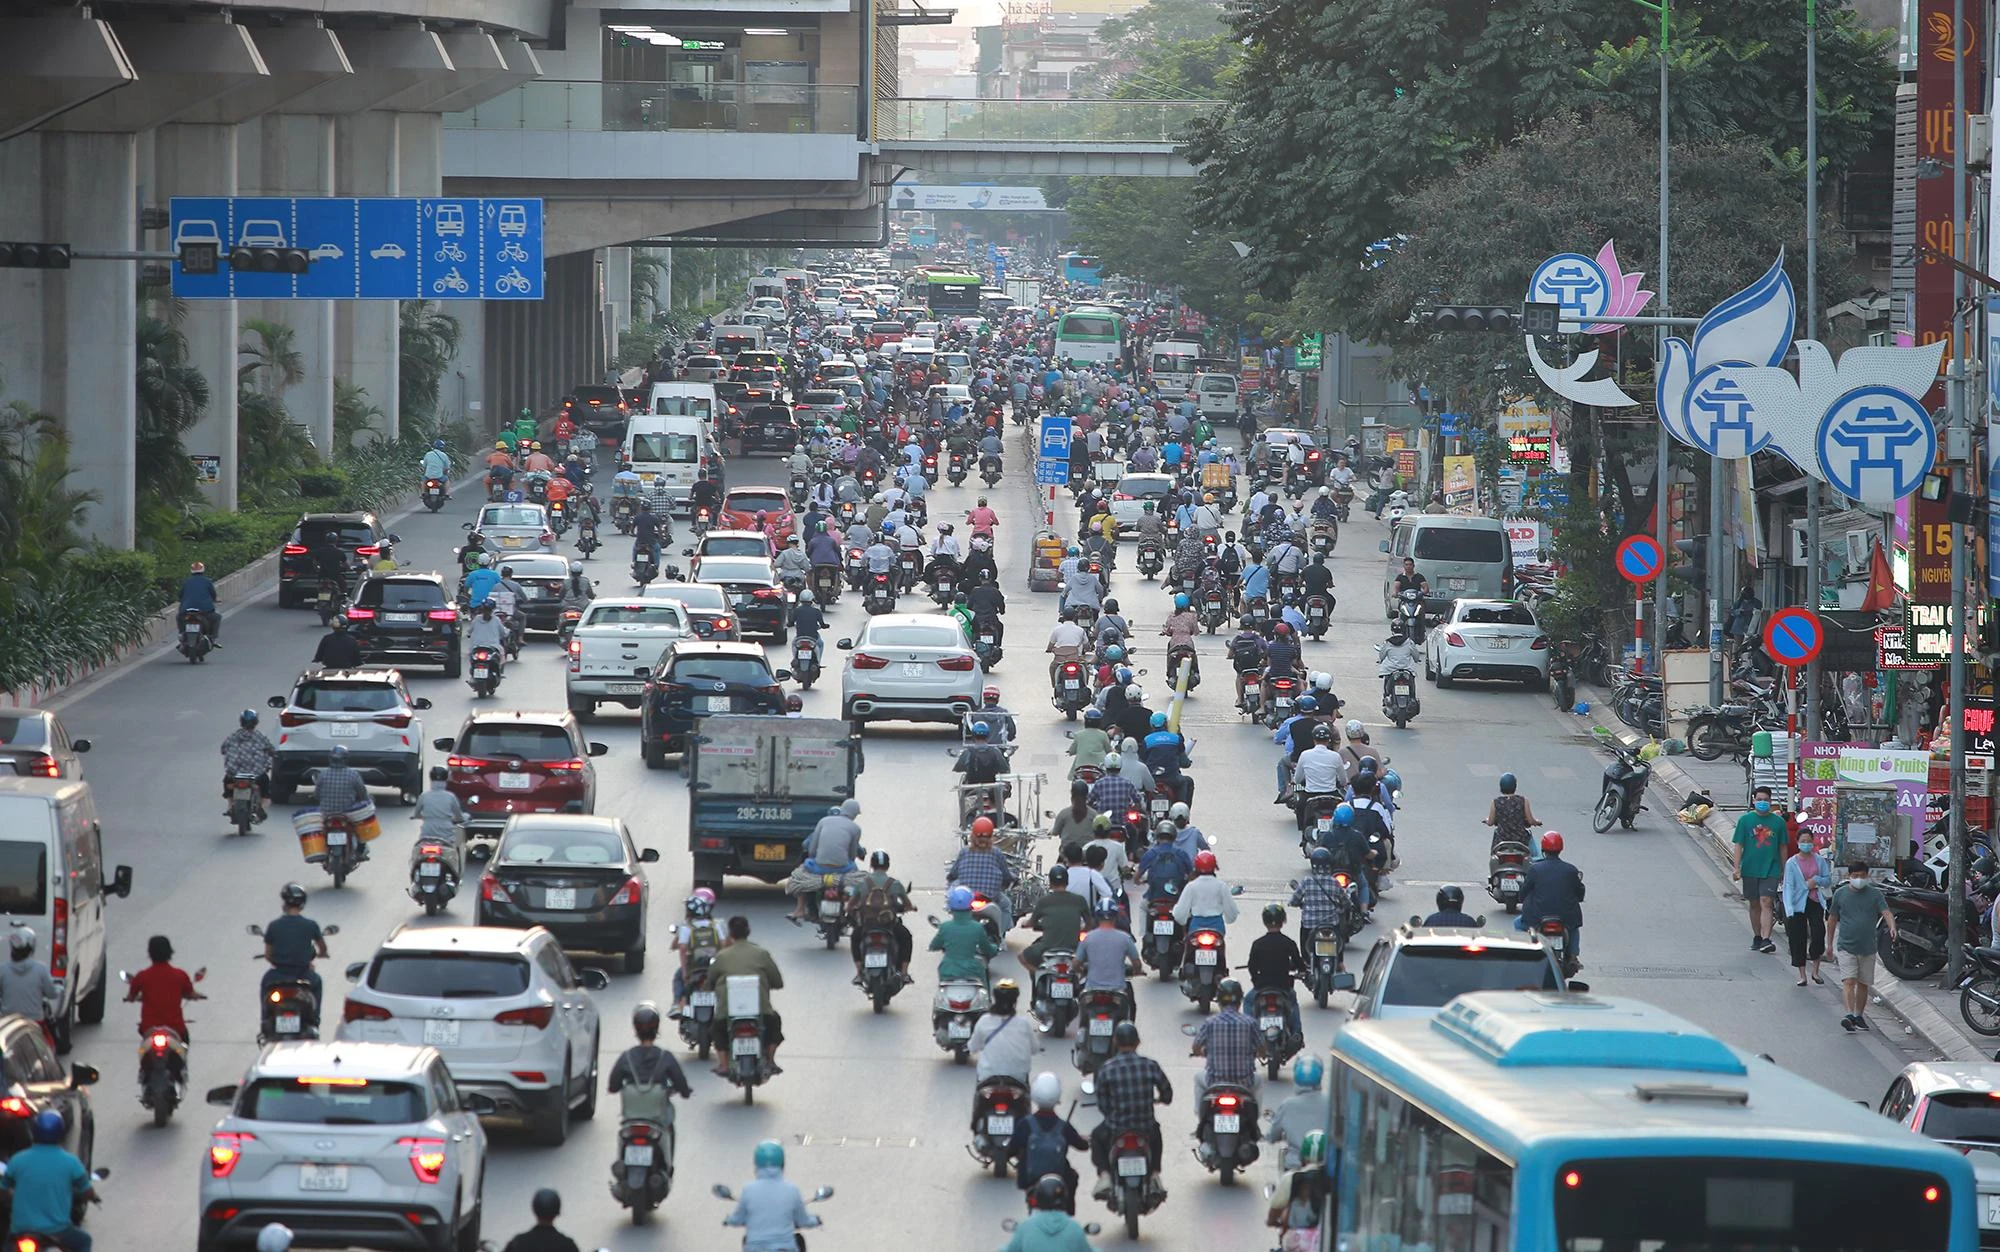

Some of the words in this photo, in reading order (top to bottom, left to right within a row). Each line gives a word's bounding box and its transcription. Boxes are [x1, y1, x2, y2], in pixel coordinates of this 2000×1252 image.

[1911, 605, 1944, 626] TRAI
[1814, 746, 1836, 756] NHO
[1840, 756, 1866, 773] King
[1868, 756, 1880, 771] of
[1894, 758, 1927, 773] Fruits
[737, 808, 792, 820] 29C-783.66
